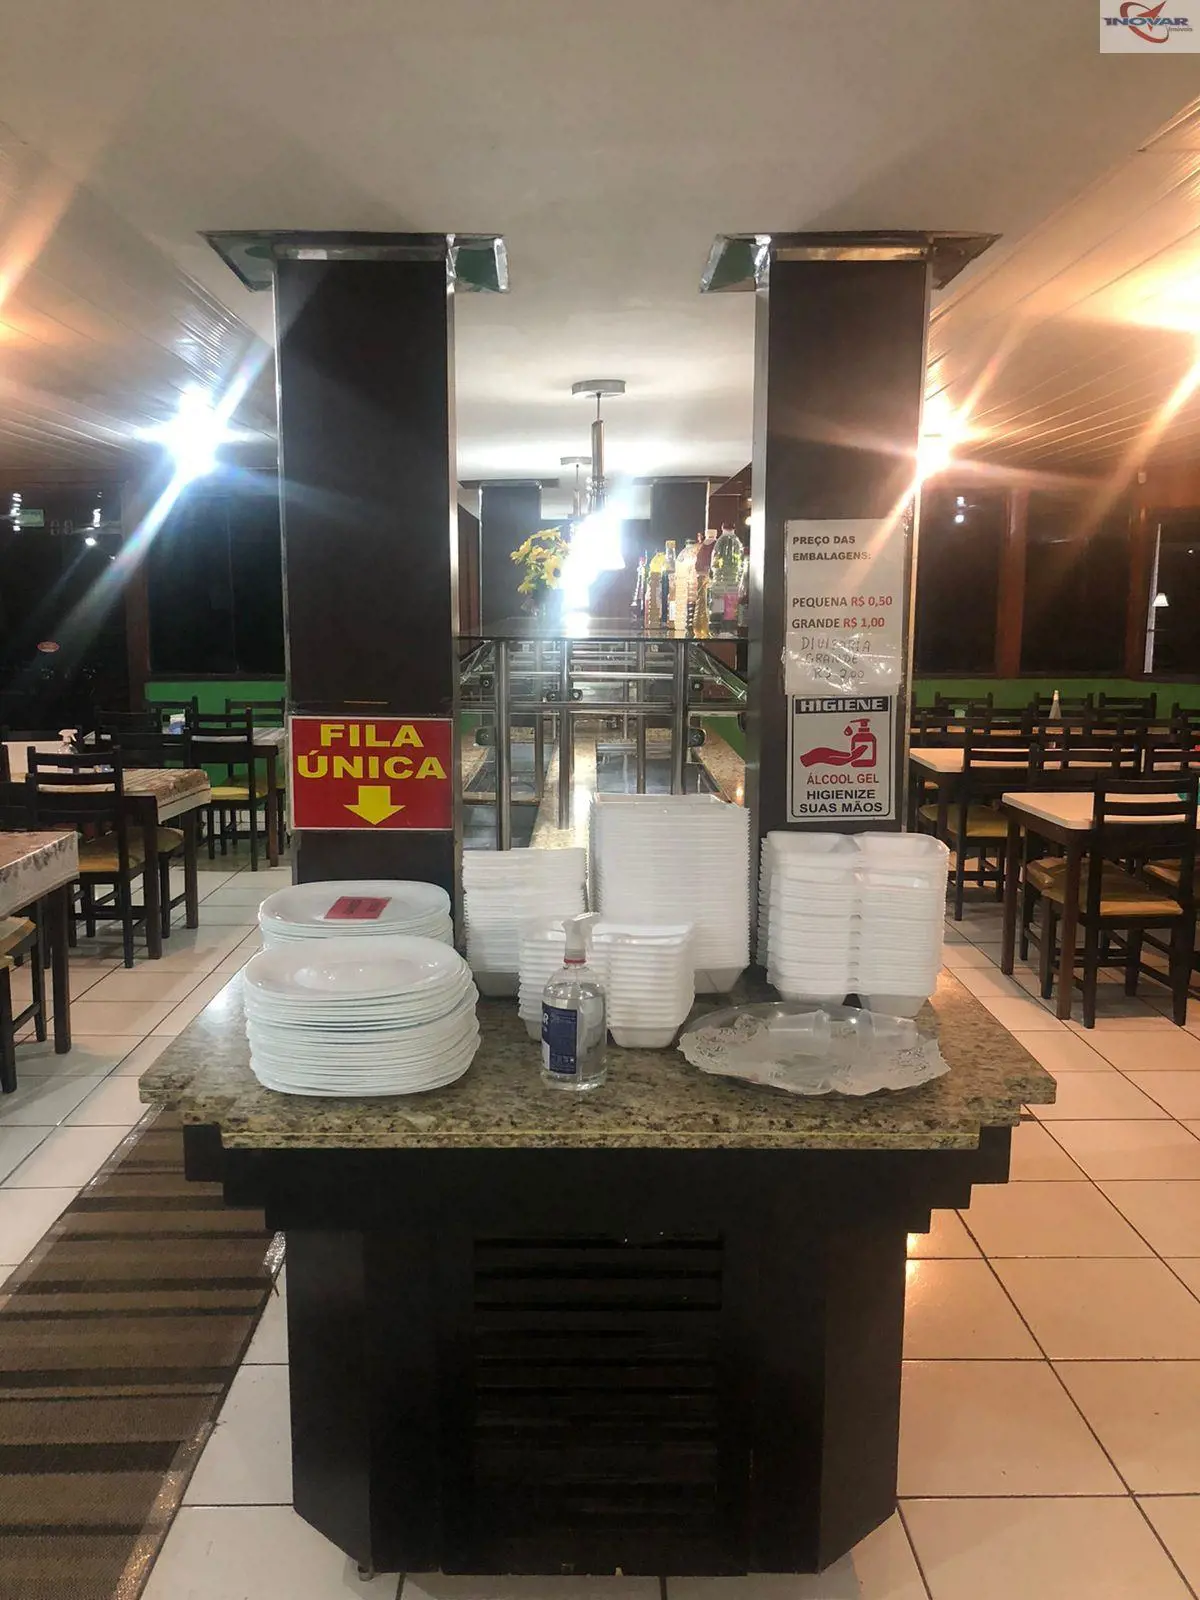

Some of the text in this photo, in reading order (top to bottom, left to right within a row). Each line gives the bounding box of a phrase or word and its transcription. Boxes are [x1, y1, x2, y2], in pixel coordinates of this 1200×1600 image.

[792, 535, 856, 546] PREÇO DAS
[792, 552, 872, 562] EMBALAGENS:
[792, 595, 893, 608] PEQUENA R$ 0,50
[791, 617, 885, 630] GRANDE R$ 1,00
[800, 698, 884, 712] HIGIENE
[320, 723, 425, 748] FILA
[297, 750, 448, 780] ÚNICA
[806, 772, 879, 785] ÁLCOOL GEL
[806, 789, 876, 800] HIGIENIZE
[799, 801, 882, 813] SUAS MÃOS
